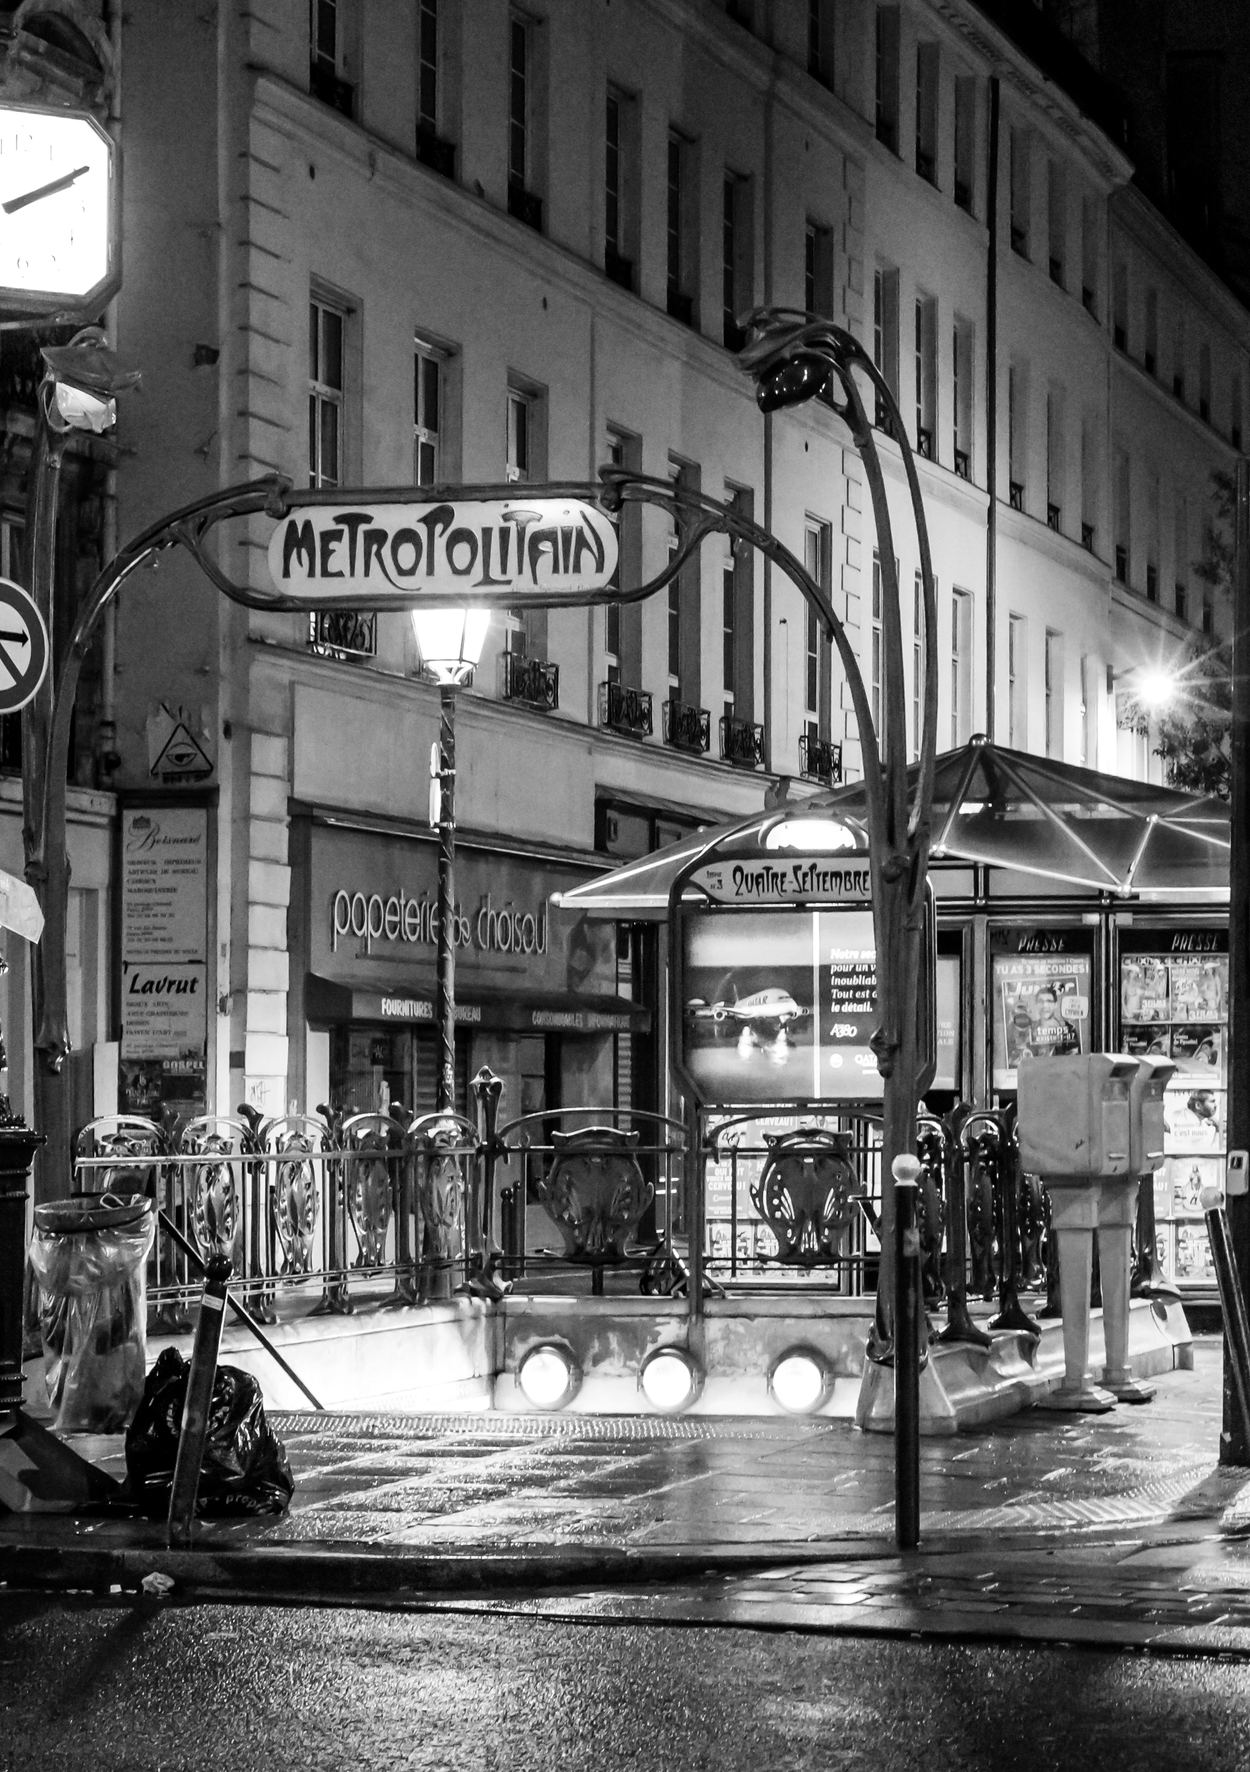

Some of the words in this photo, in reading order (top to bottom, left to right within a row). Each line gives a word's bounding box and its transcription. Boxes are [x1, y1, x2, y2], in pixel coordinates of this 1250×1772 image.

[281, 505, 606, 591] METROPOLITAIN
[333, 888, 439, 954] papeterie
[1018, 936, 1065, 952] PRESSE
[1171, 933, 1218, 951] PRESSE
[830, 948, 858, 959] Notre
[830, 964, 854, 975] pour
[855, 964, 868, 972] un
[996, 964, 1009, 974] TU
[1010, 964, 1025, 974] AS
[1026, 964, 1032, 974] 3
[128, 972, 199, 994] Lavrut
[831, 989, 853, 999] Tout
[855, 989, 870, 999] est
[381, 997, 434, 1019] FOURNITURES
[829, 1023, 858, 1038] A380
[1036, 1026, 1069, 1036] temps
